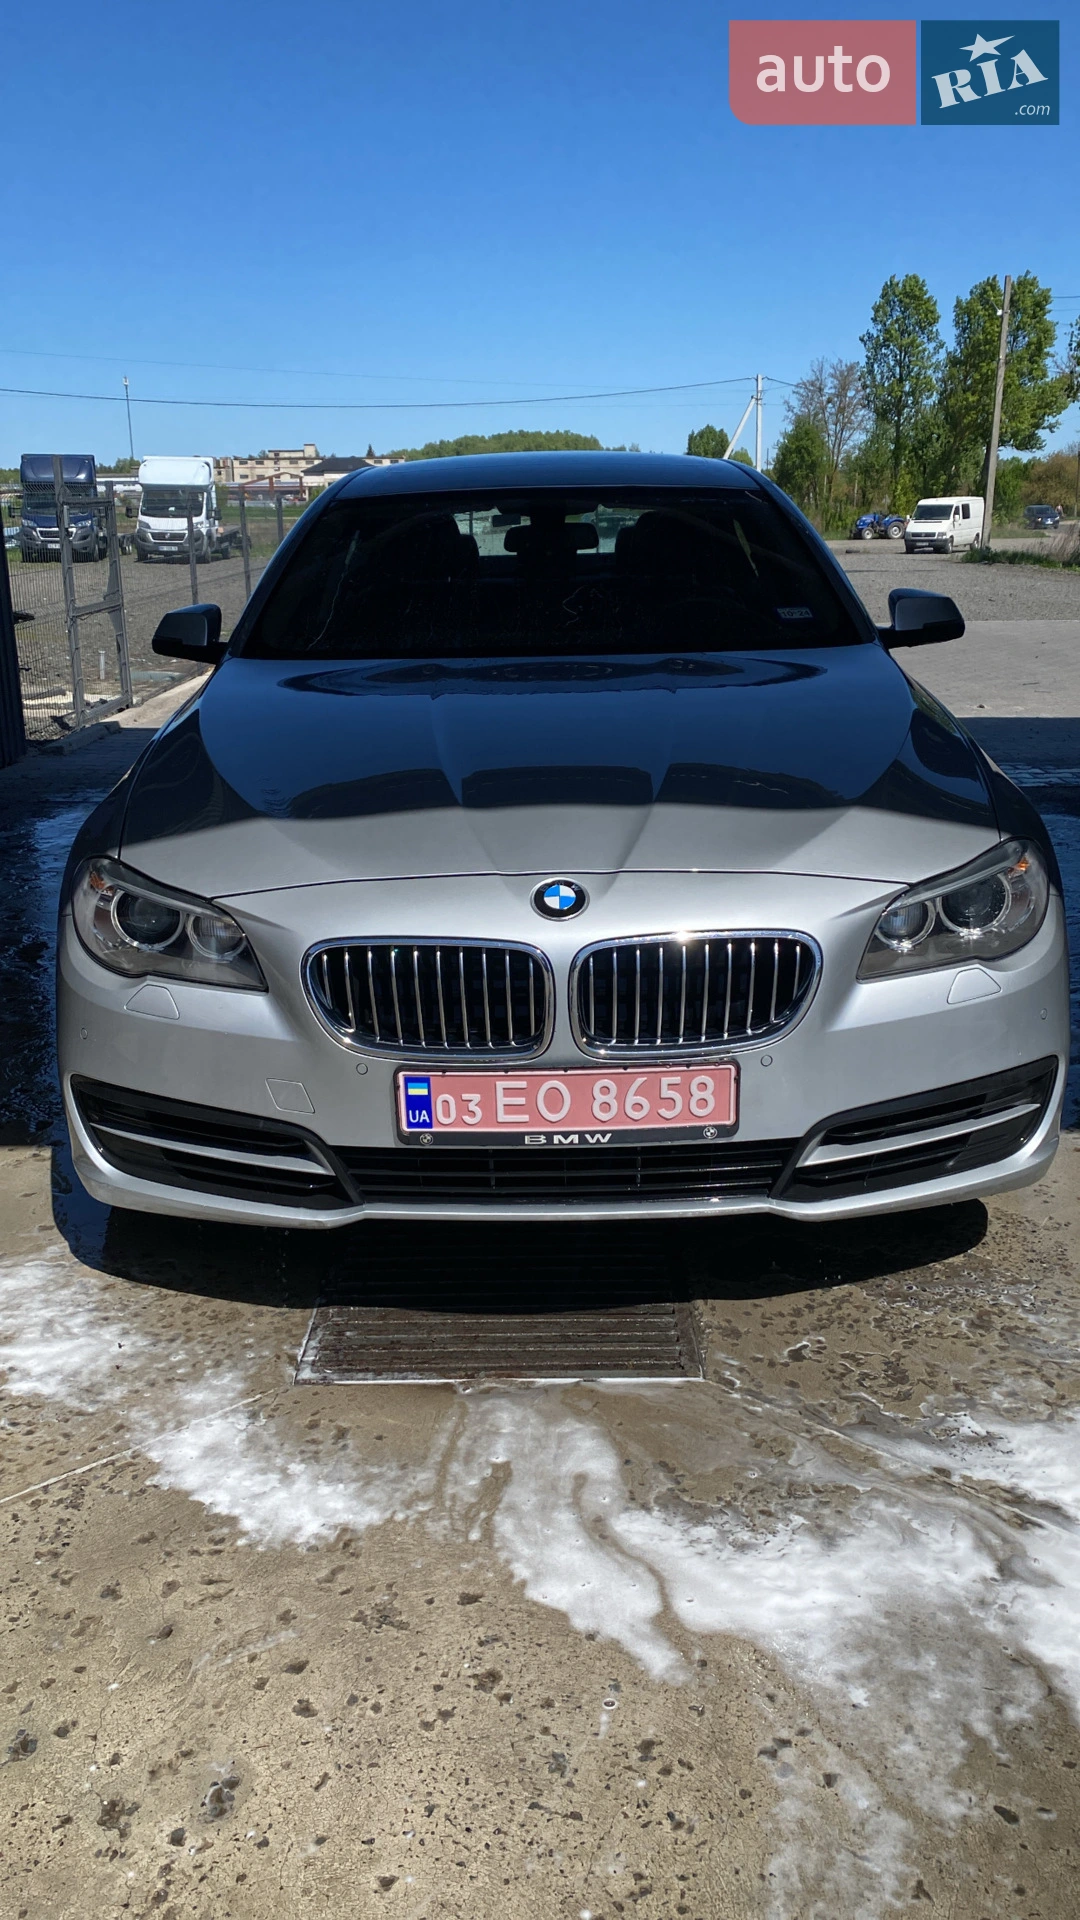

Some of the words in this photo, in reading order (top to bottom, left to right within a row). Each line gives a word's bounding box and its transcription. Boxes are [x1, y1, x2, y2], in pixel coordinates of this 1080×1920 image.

[436, 1093, 483, 1125] 03
[495, 1080, 571, 1123] EO
[591, 1075, 716, 1122] 8658
[408, 1110, 431, 1123] UA
[524, 1133, 613, 1145] BMW
